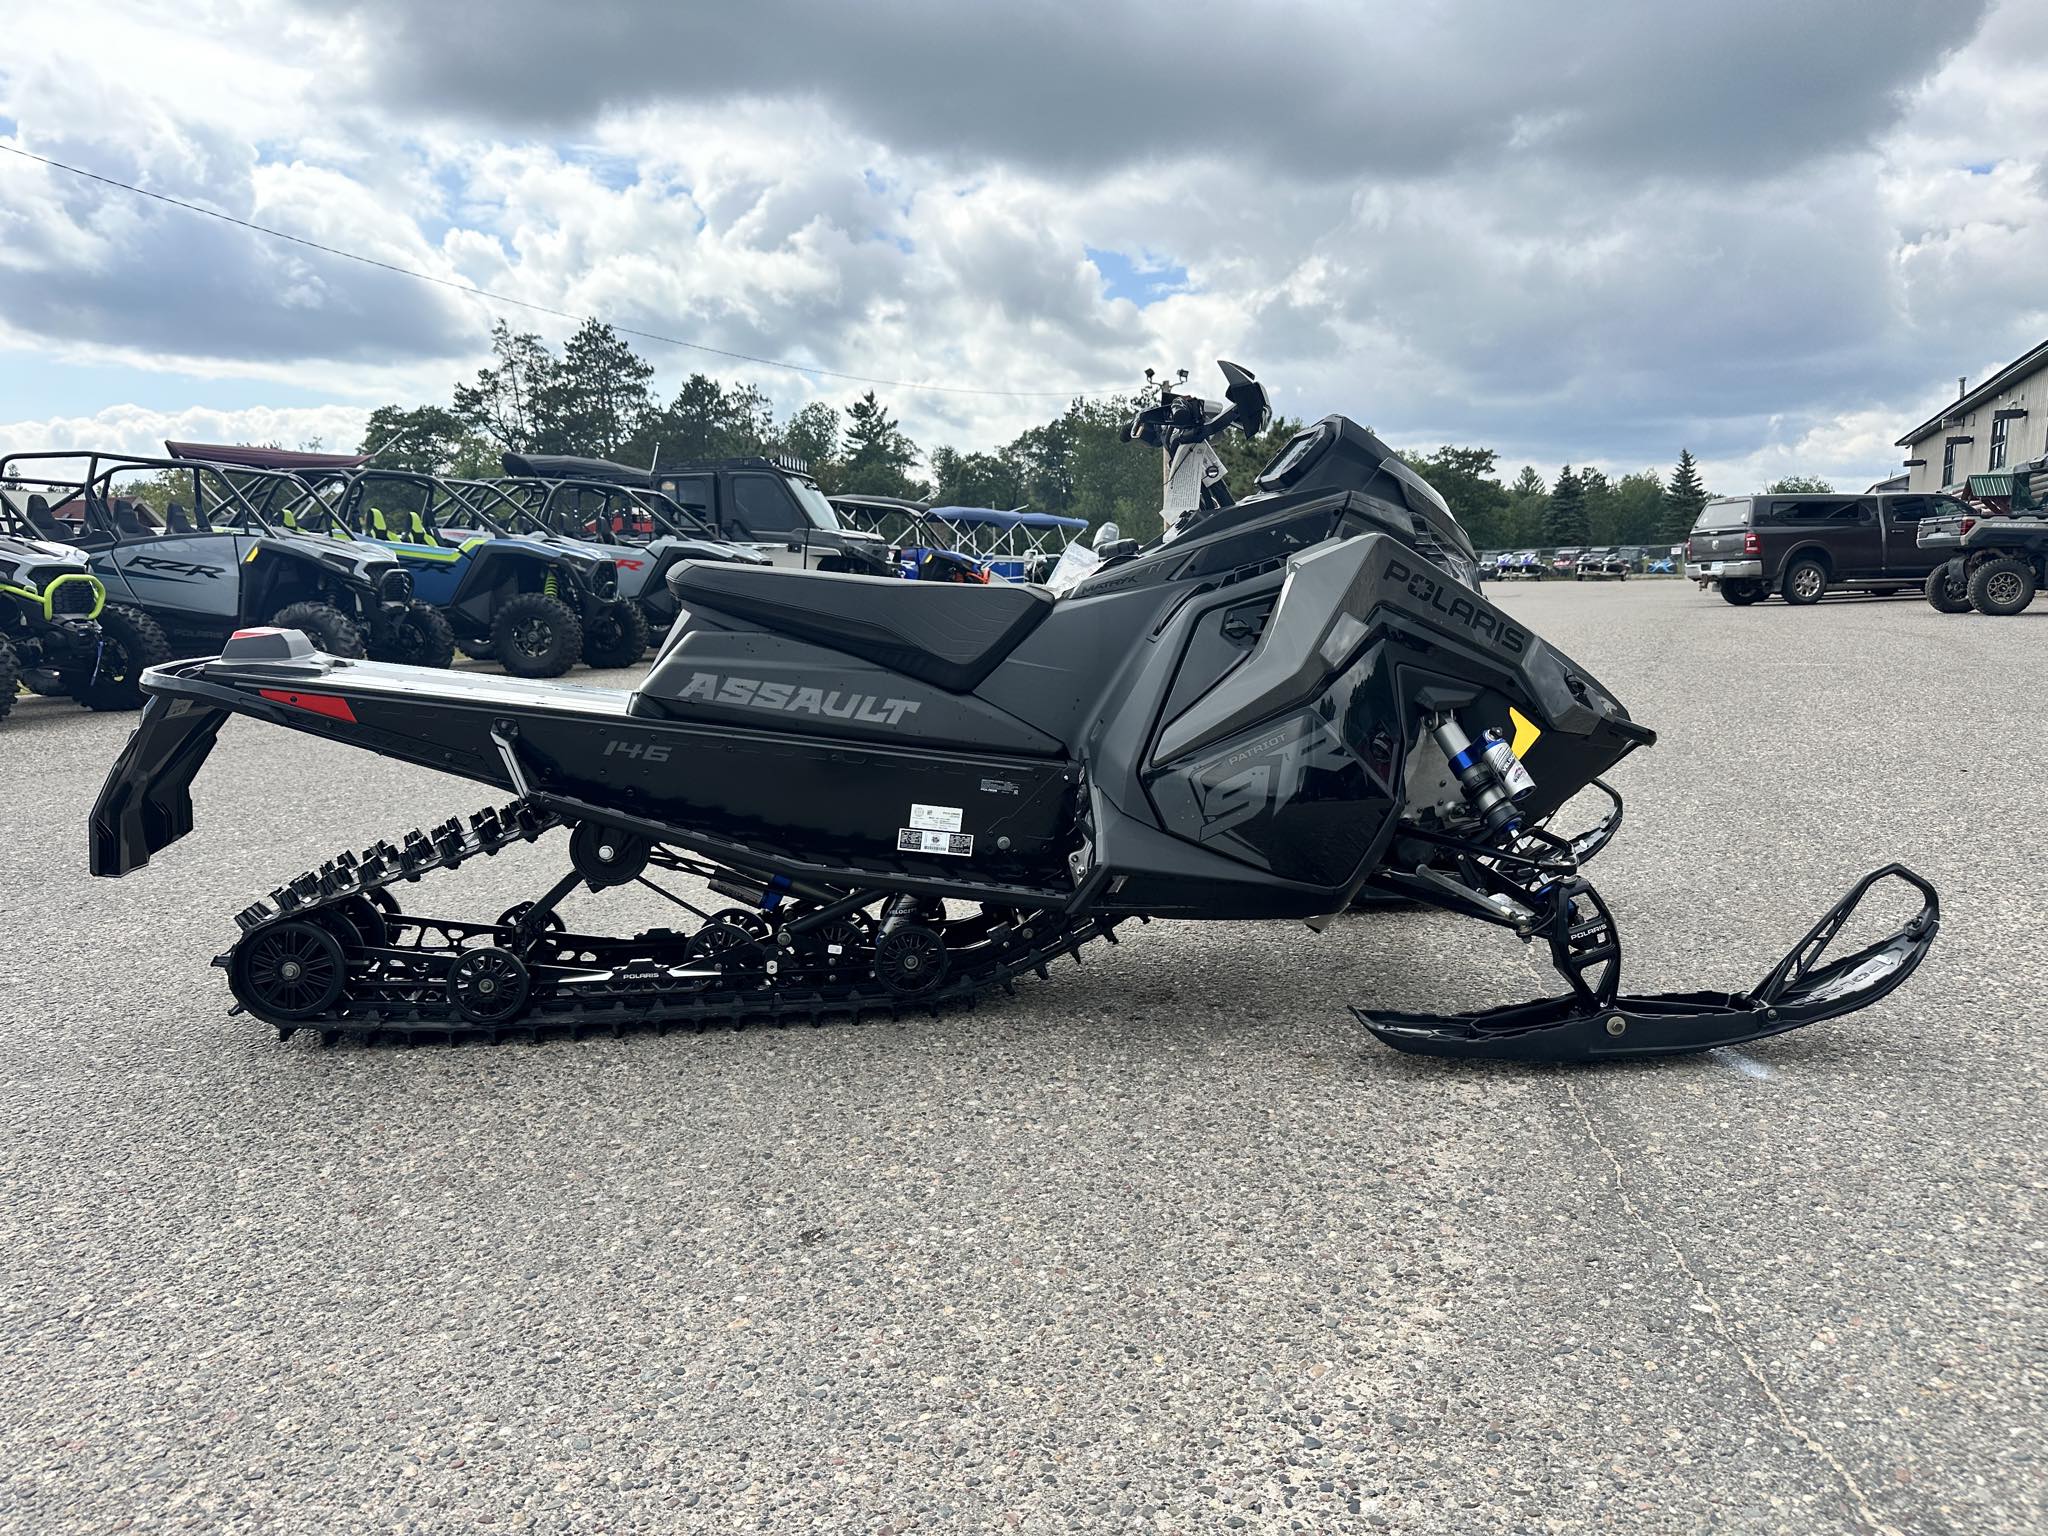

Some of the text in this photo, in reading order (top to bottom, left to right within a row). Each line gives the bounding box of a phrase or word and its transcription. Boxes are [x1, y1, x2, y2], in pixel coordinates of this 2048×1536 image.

[125, 555, 227, 580] RZR
[1081, 576, 1138, 595] MATRYX
[1383, 559, 1525, 654] POLARIS
[677, 671, 921, 726] ASSAULT
[603, 740, 673, 763] 146
[1228, 732, 1287, 767] PATRIOT
[1570, 923, 1607, 941] POLARIS
[623, 972, 660, 980] POLARIS
